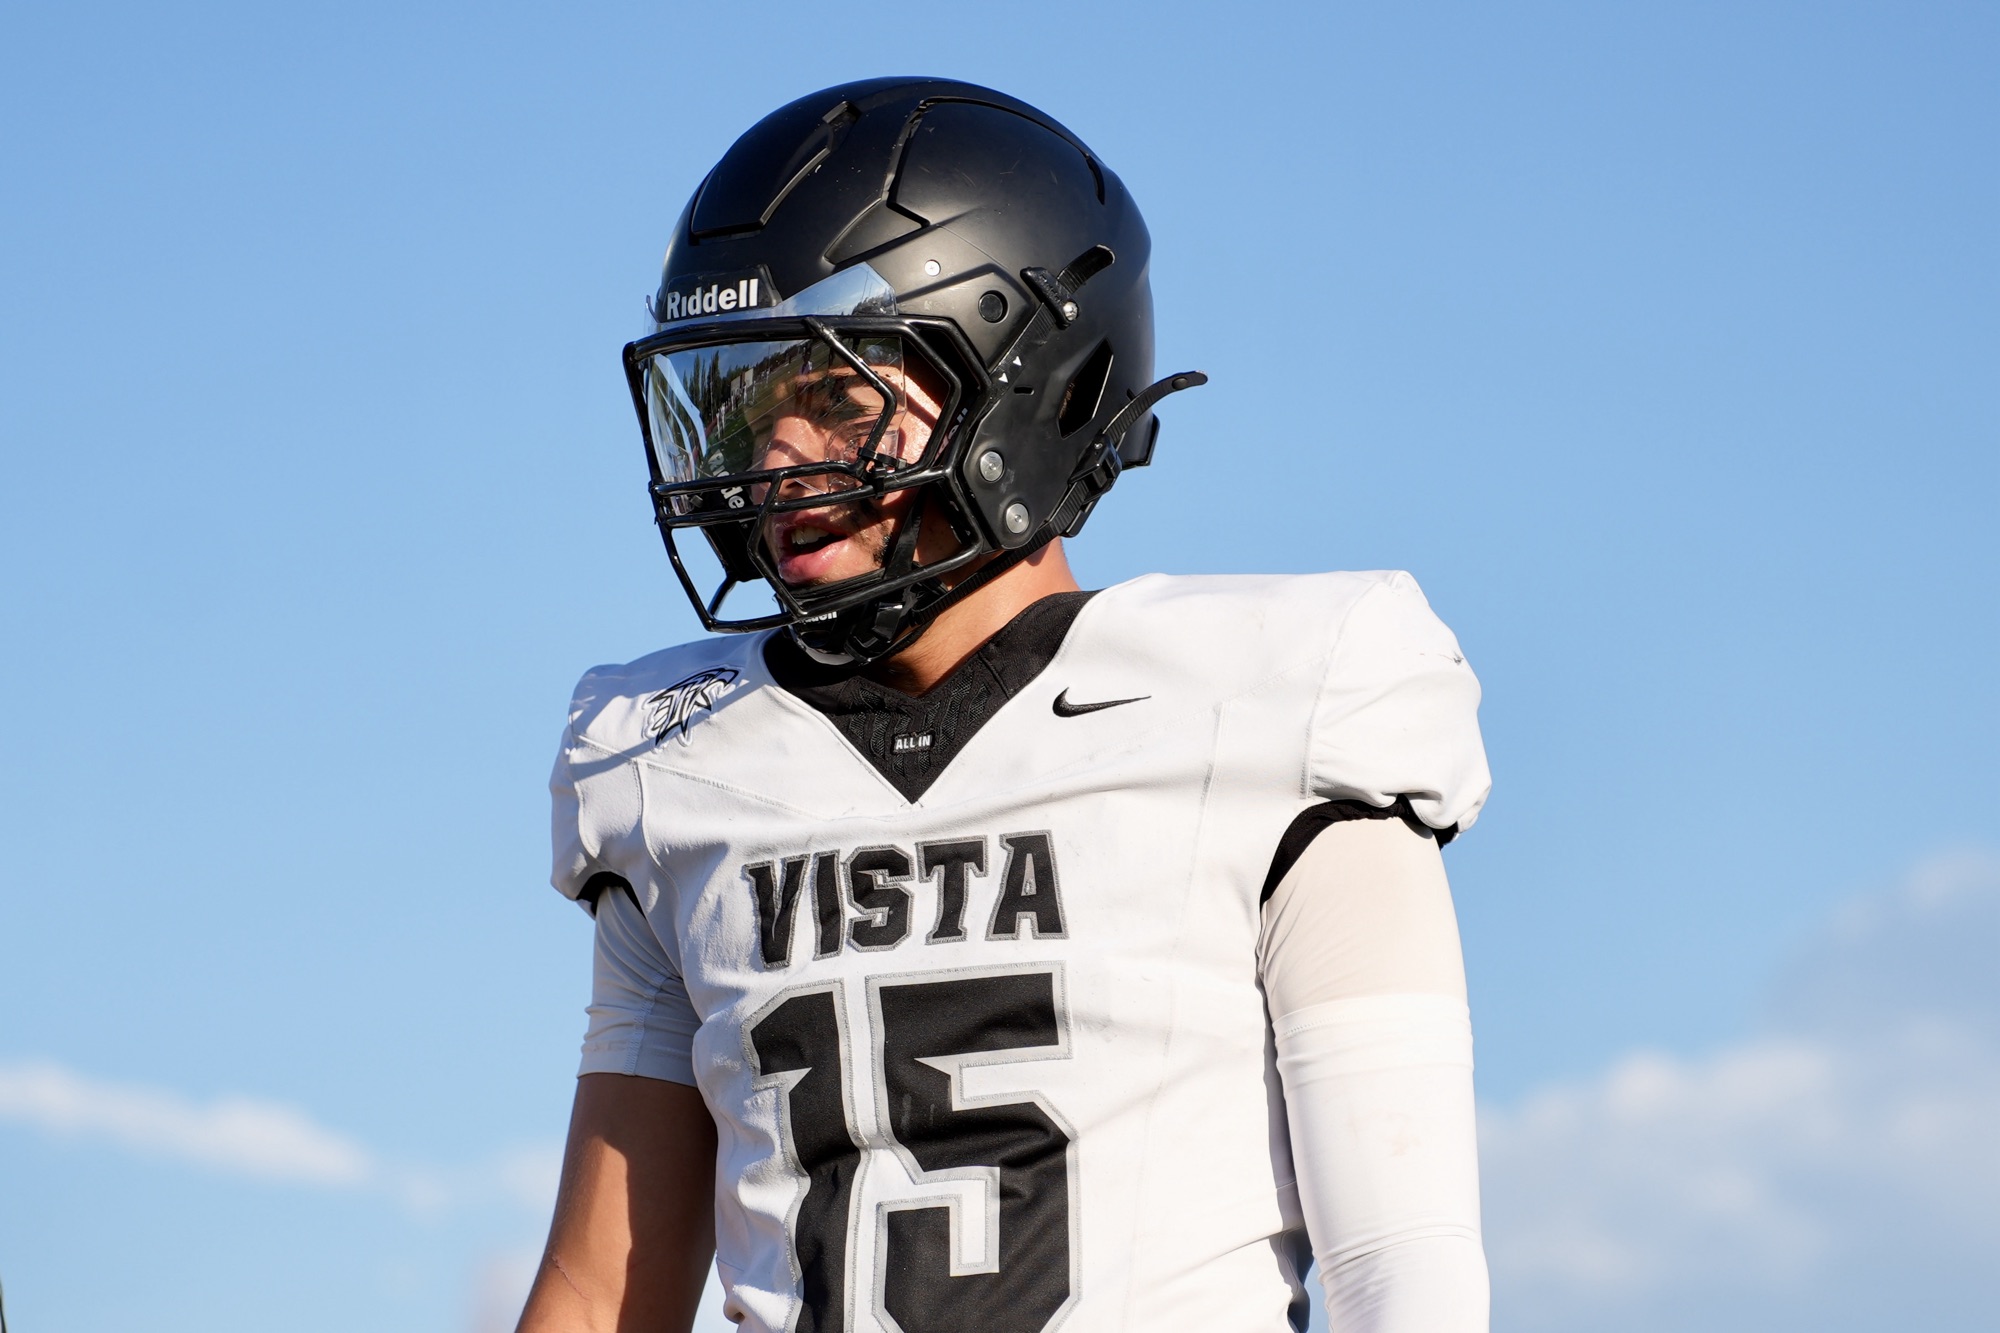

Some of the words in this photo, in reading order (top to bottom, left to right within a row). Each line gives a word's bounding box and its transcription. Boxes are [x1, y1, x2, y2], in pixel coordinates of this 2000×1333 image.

[666, 278, 759, 320] Riddell
[895, 737, 916, 750] ALL
[918, 734, 931, 747] IN
[743, 829, 1070, 970] VISTA
[740, 960, 1082, 1333] 15
